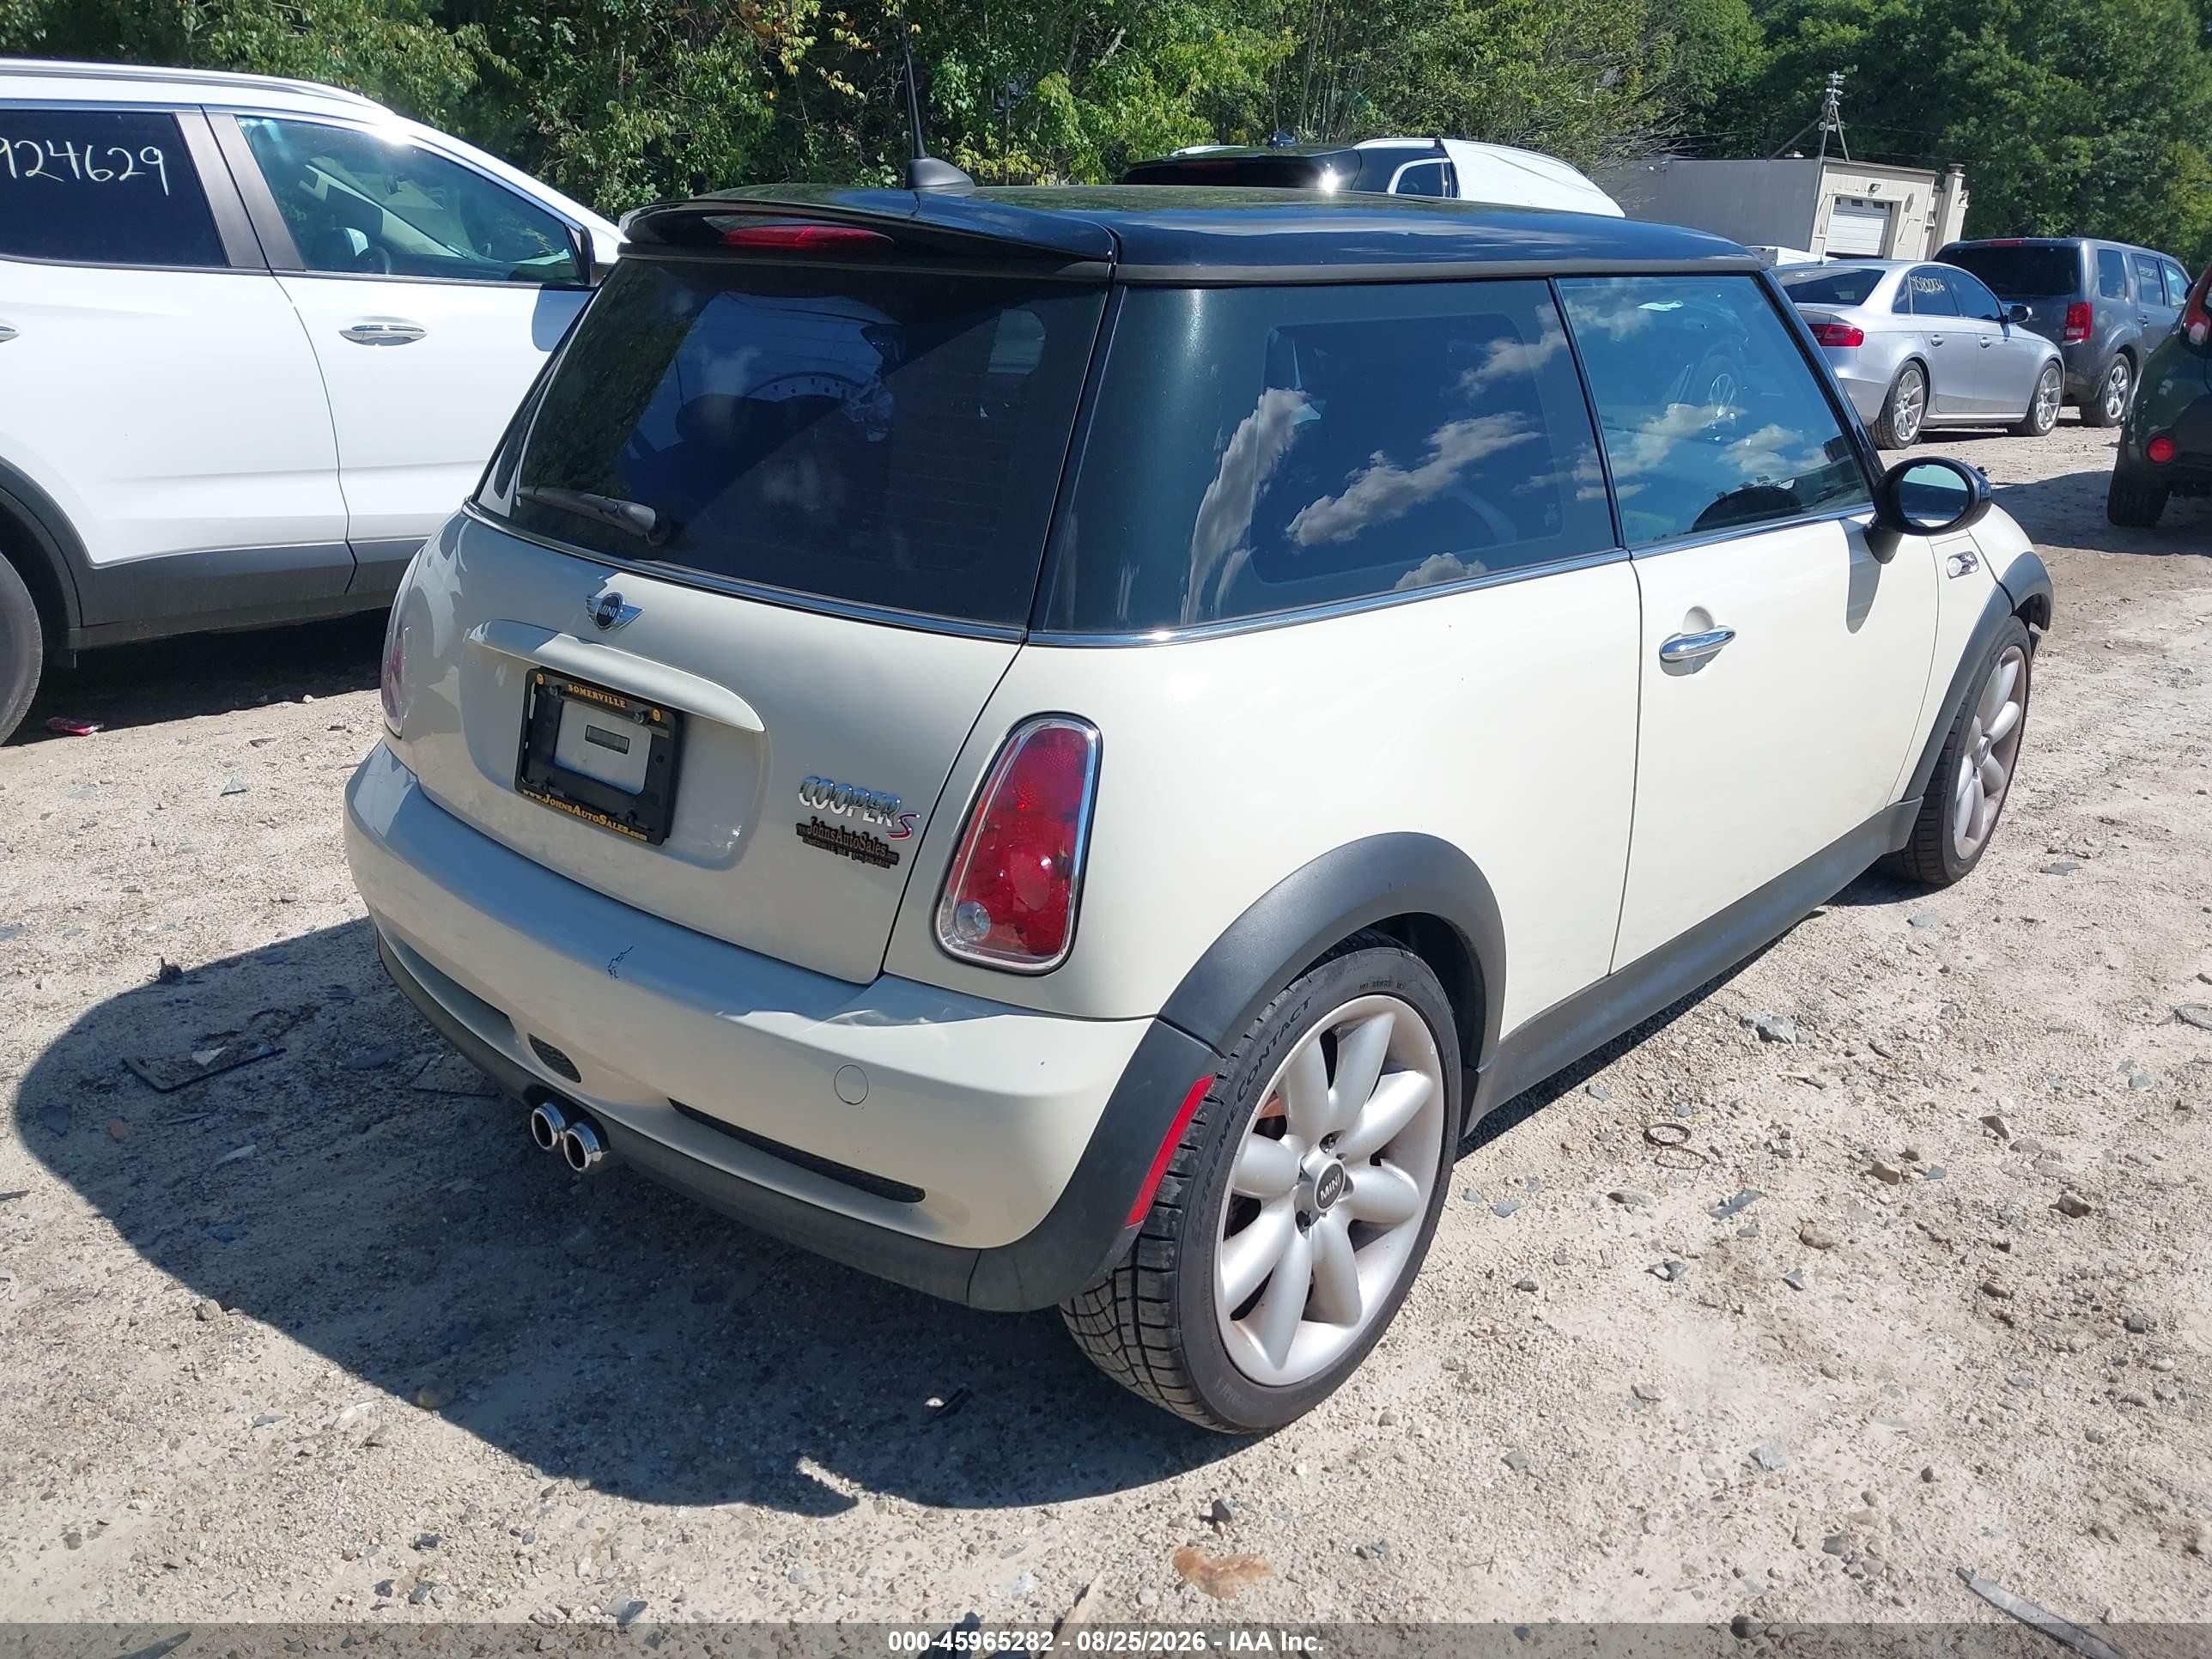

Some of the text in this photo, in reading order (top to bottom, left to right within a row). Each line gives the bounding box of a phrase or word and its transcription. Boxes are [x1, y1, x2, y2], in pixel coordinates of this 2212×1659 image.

[0, 137, 169, 197] 924629
[599, 604, 618, 618] MINI
[568, 684, 627, 708] SOMERVILLE
[798, 776, 921, 841] COOPER S
[1320, 1172, 1341, 1201] MINI
